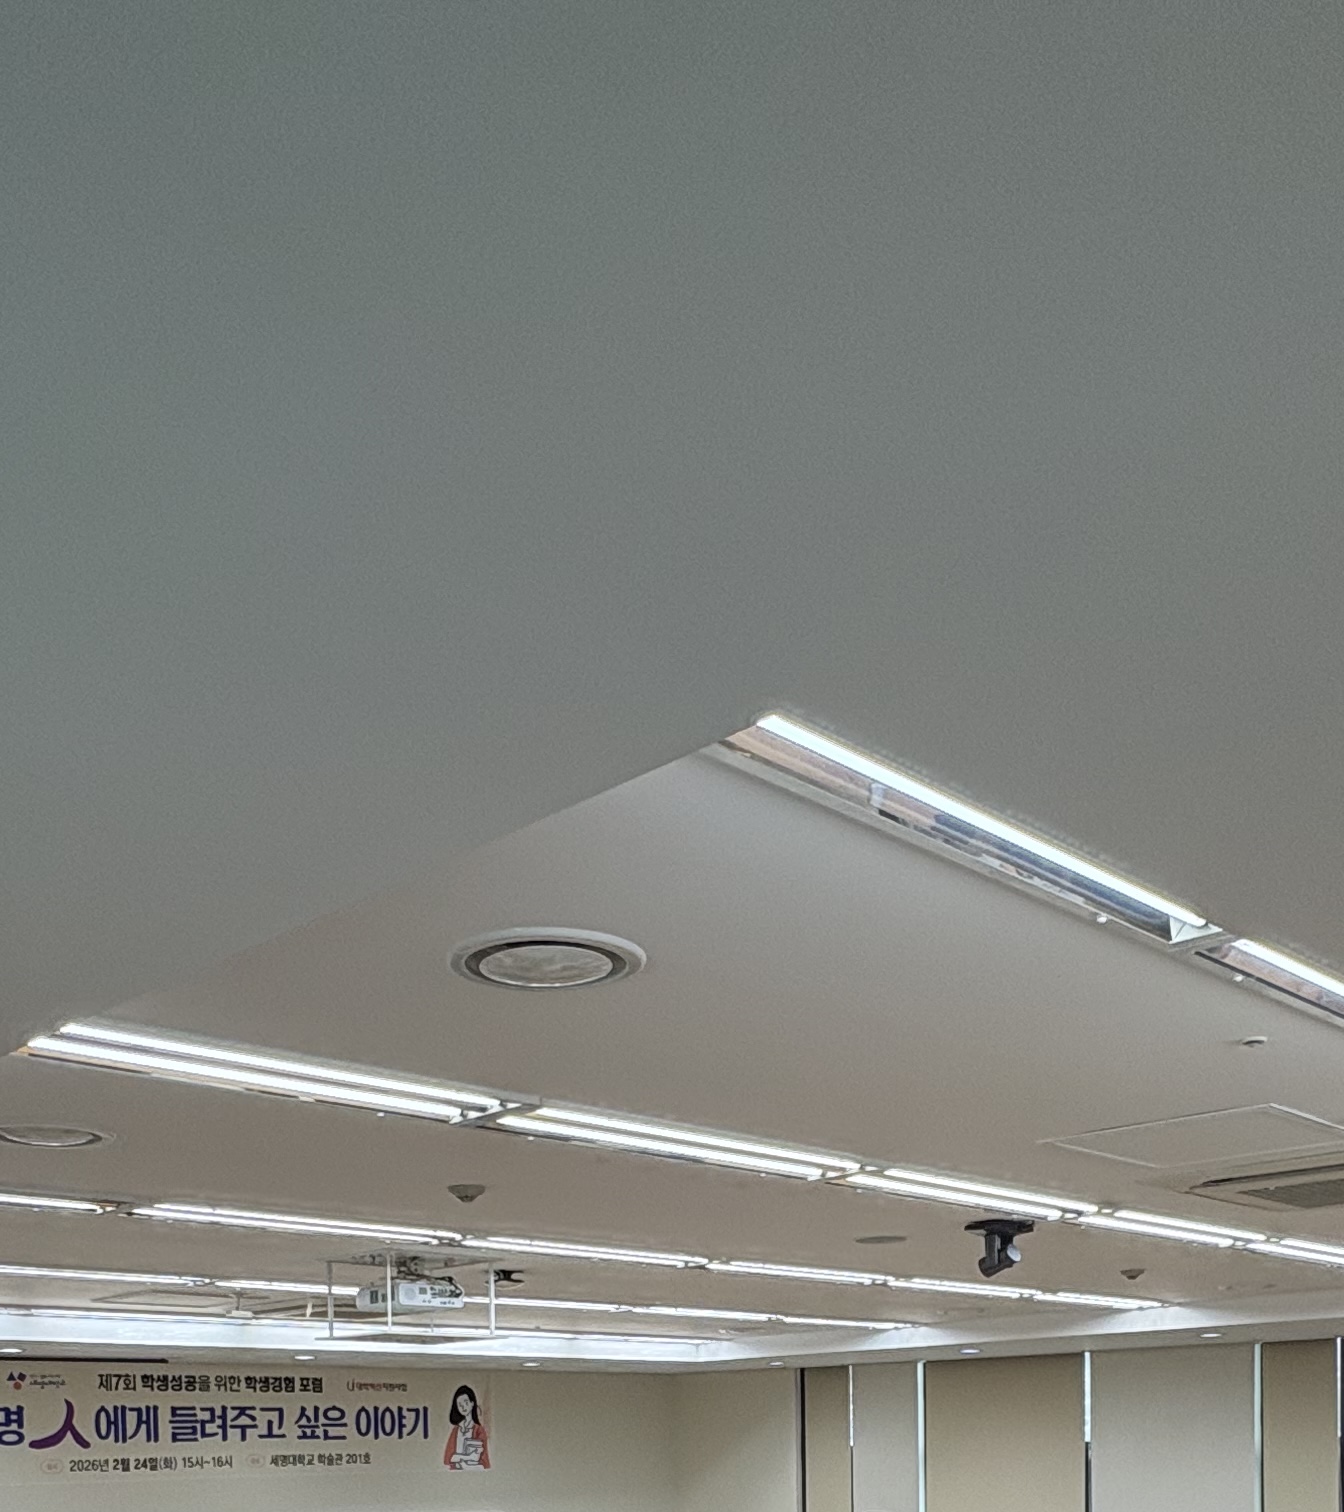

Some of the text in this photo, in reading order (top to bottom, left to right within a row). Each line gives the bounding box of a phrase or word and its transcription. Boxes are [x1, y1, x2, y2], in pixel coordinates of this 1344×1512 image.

[97, 1373, 324, 1393] 제7회 학생성공을 위한 학생경험 포럼
[169, 1405, 287, 1442] 들려주고
[295, 1405, 348, 1441] 싶은
[355, 1405, 429, 1440] 이야기
[69, 1458, 109, 1472] 2026년
[112, 1457, 131, 1472] 2월
